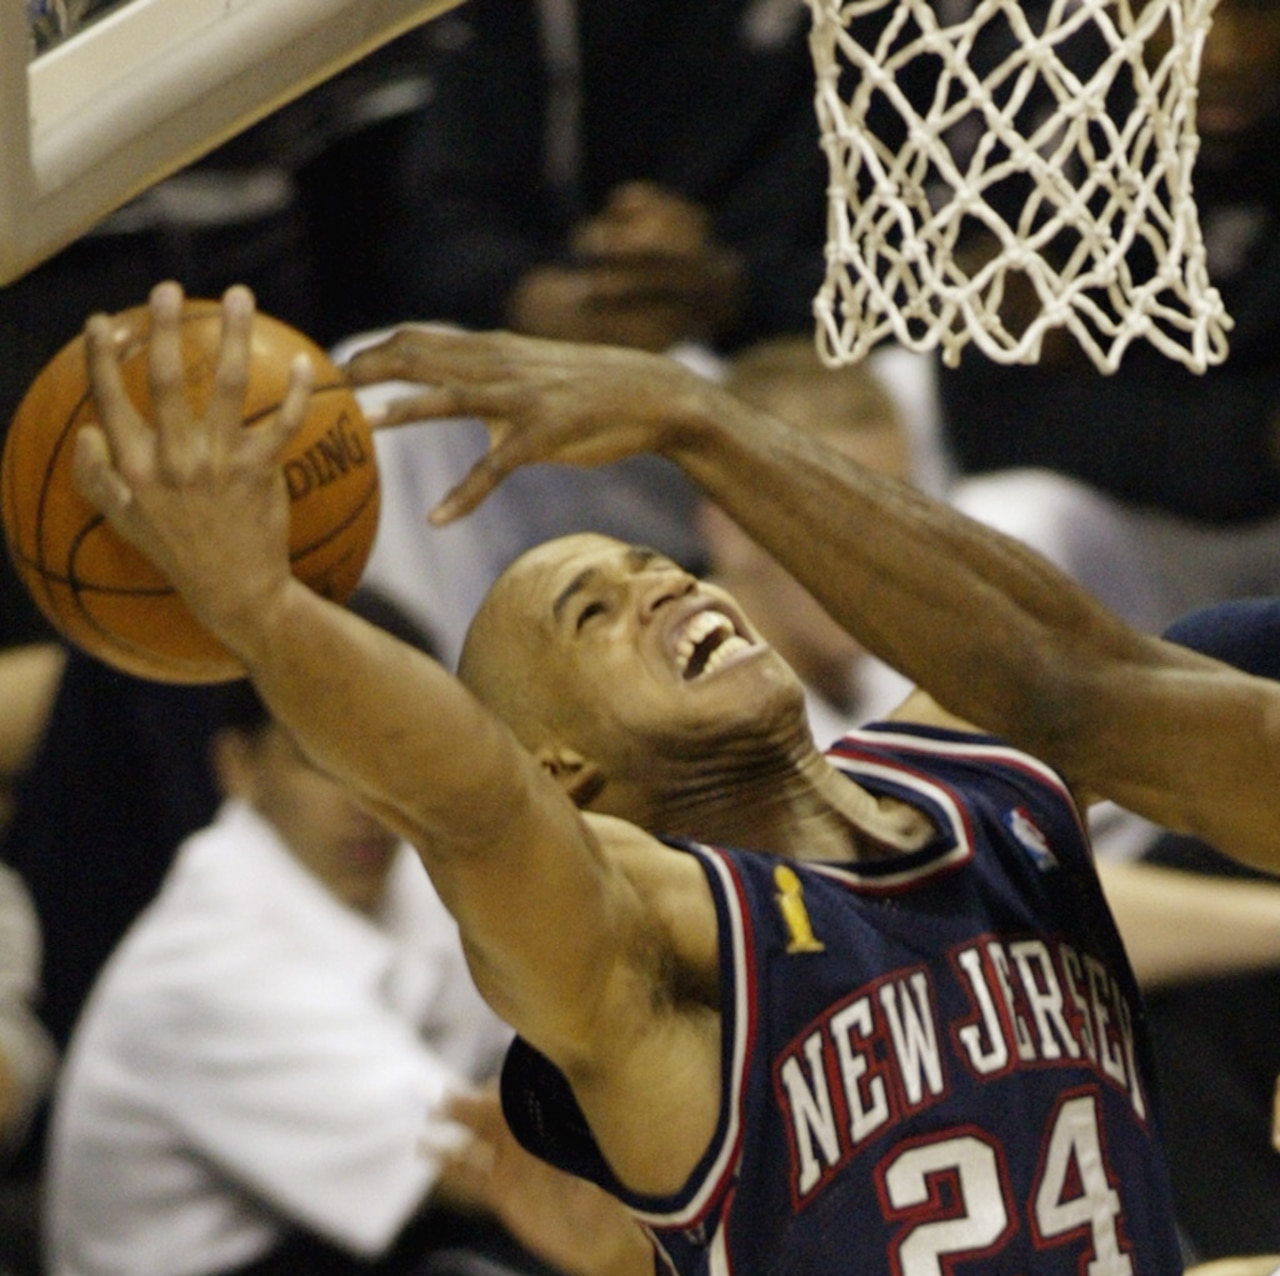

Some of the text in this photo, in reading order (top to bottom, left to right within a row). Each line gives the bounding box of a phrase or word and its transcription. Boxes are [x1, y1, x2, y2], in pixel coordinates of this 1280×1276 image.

[283, 409, 367, 502] DING
[775, 935, 1150, 1208] NEW JERSEY
